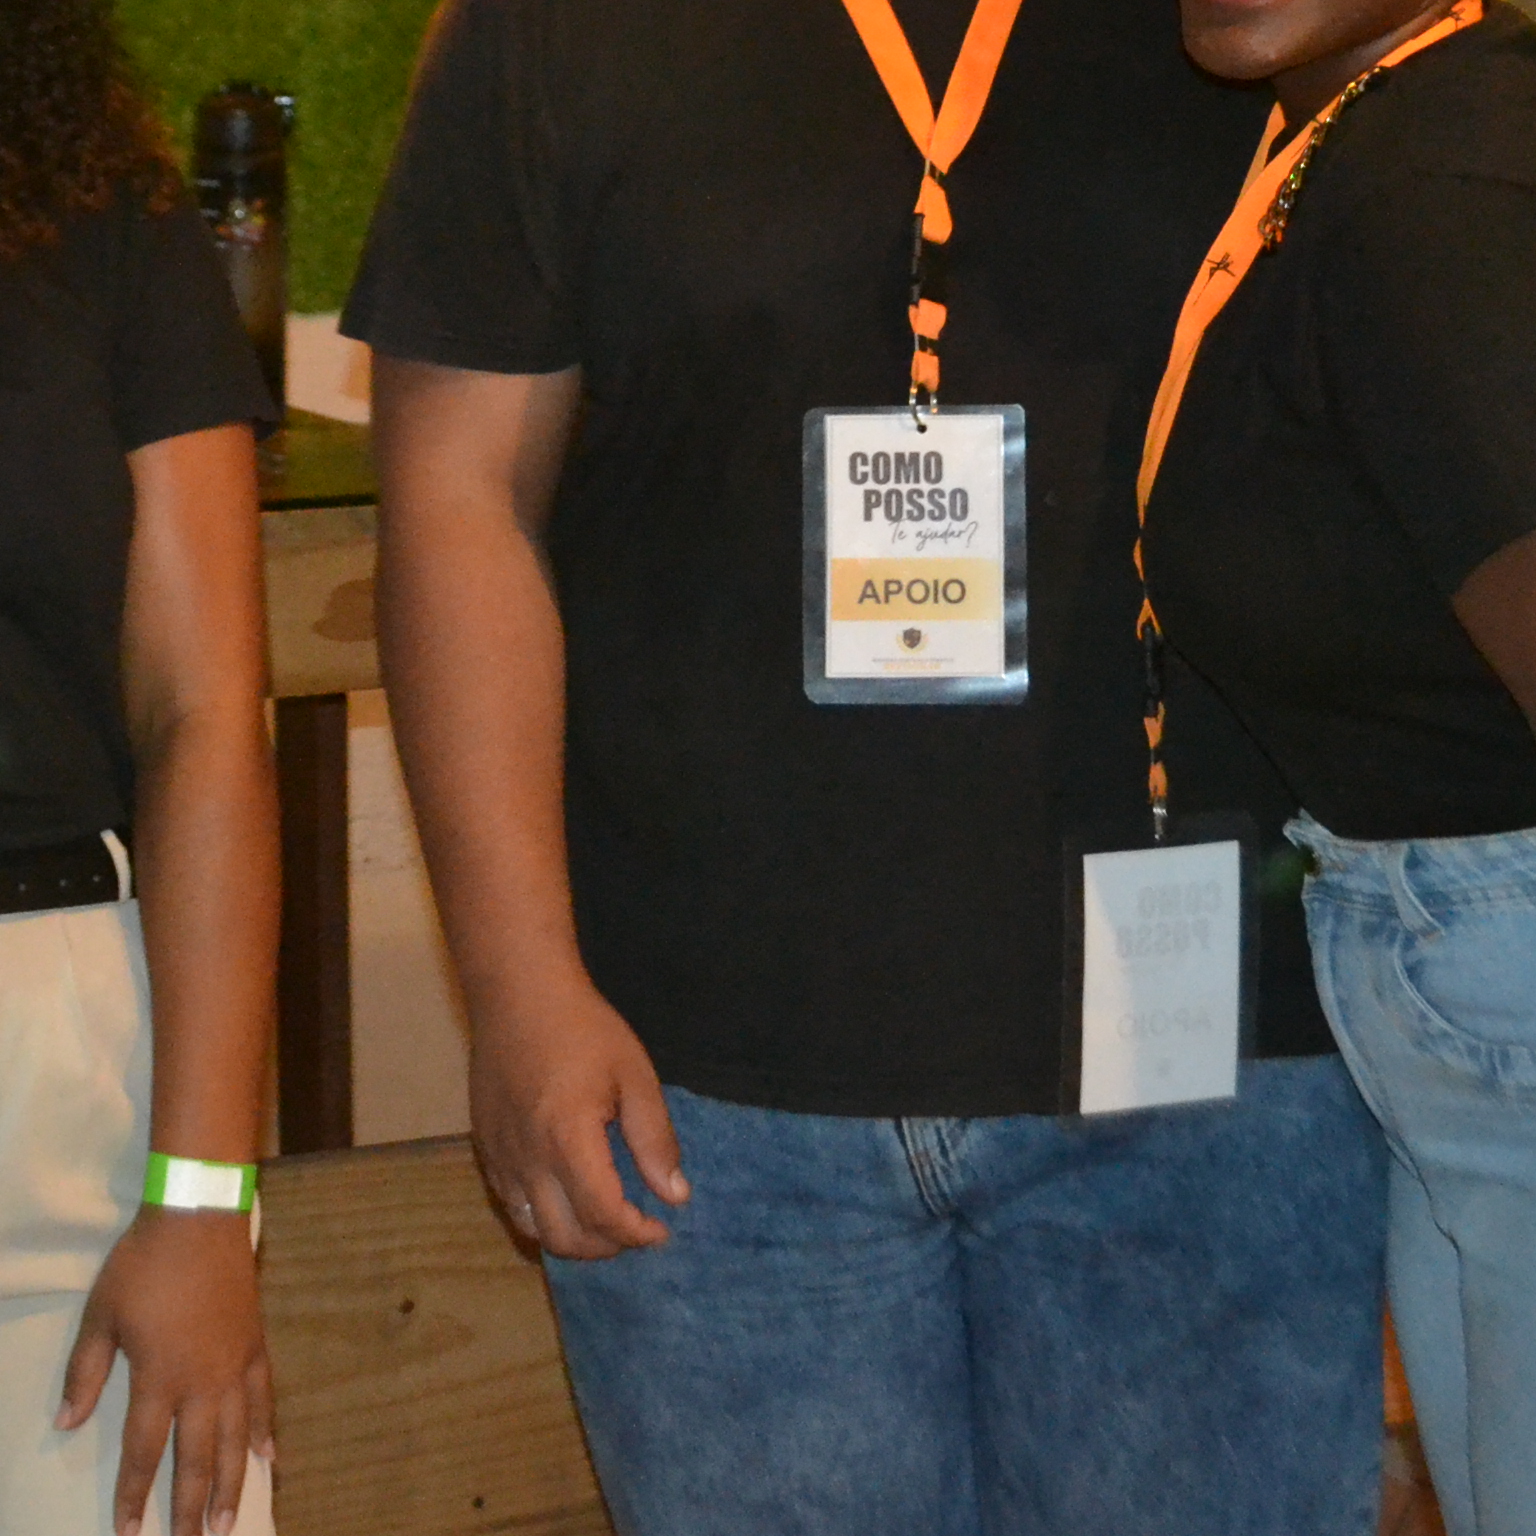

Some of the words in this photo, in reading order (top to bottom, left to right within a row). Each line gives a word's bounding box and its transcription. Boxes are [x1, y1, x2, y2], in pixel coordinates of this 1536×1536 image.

[848, 450, 943, 485] COMO
[863, 487, 969, 522] POSSO
[915, 521, 980, 553] ajudar?
[857, 578, 967, 606] APOIO
